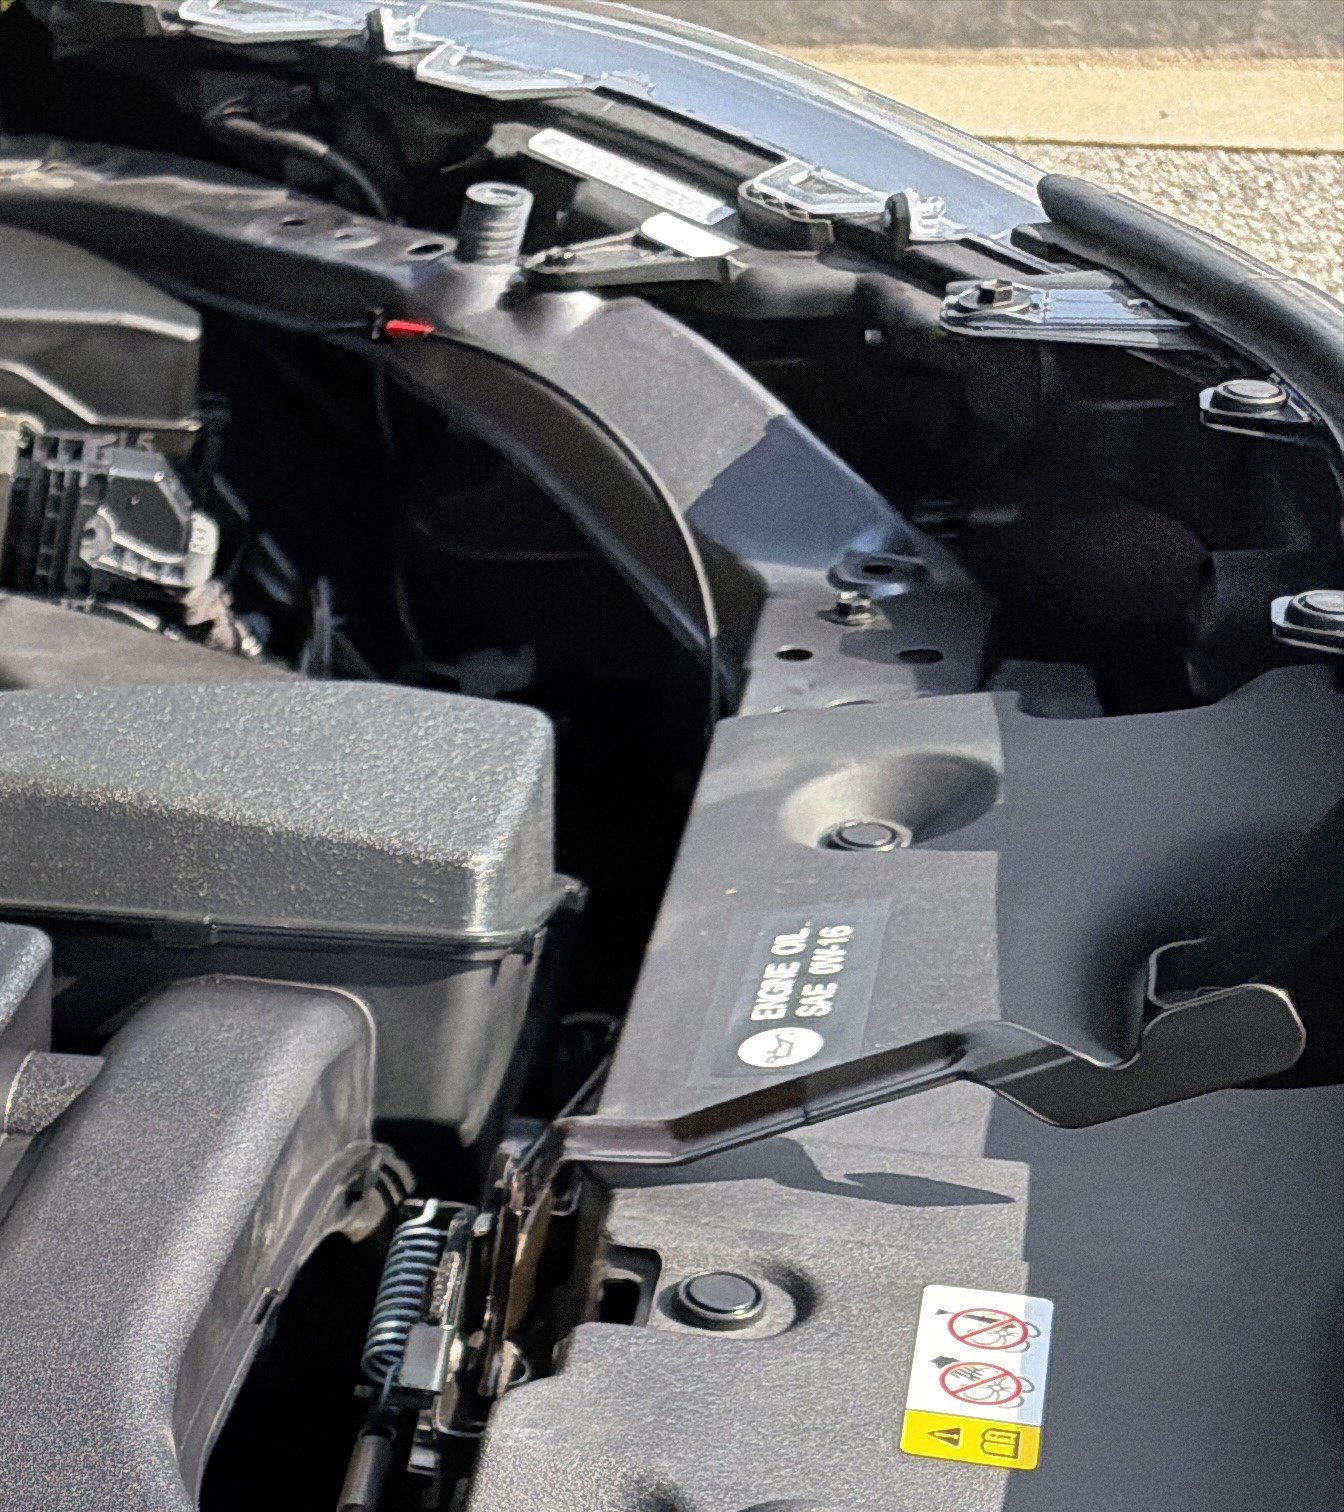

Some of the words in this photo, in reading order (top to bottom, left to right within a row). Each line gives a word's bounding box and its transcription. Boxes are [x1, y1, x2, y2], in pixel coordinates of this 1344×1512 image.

[770, 927, 812, 956] OIL
[808, 925, 855, 976] 0W-16
[749, 961, 802, 1021] ENGINE
[795, 982, 839, 1018] SAE
